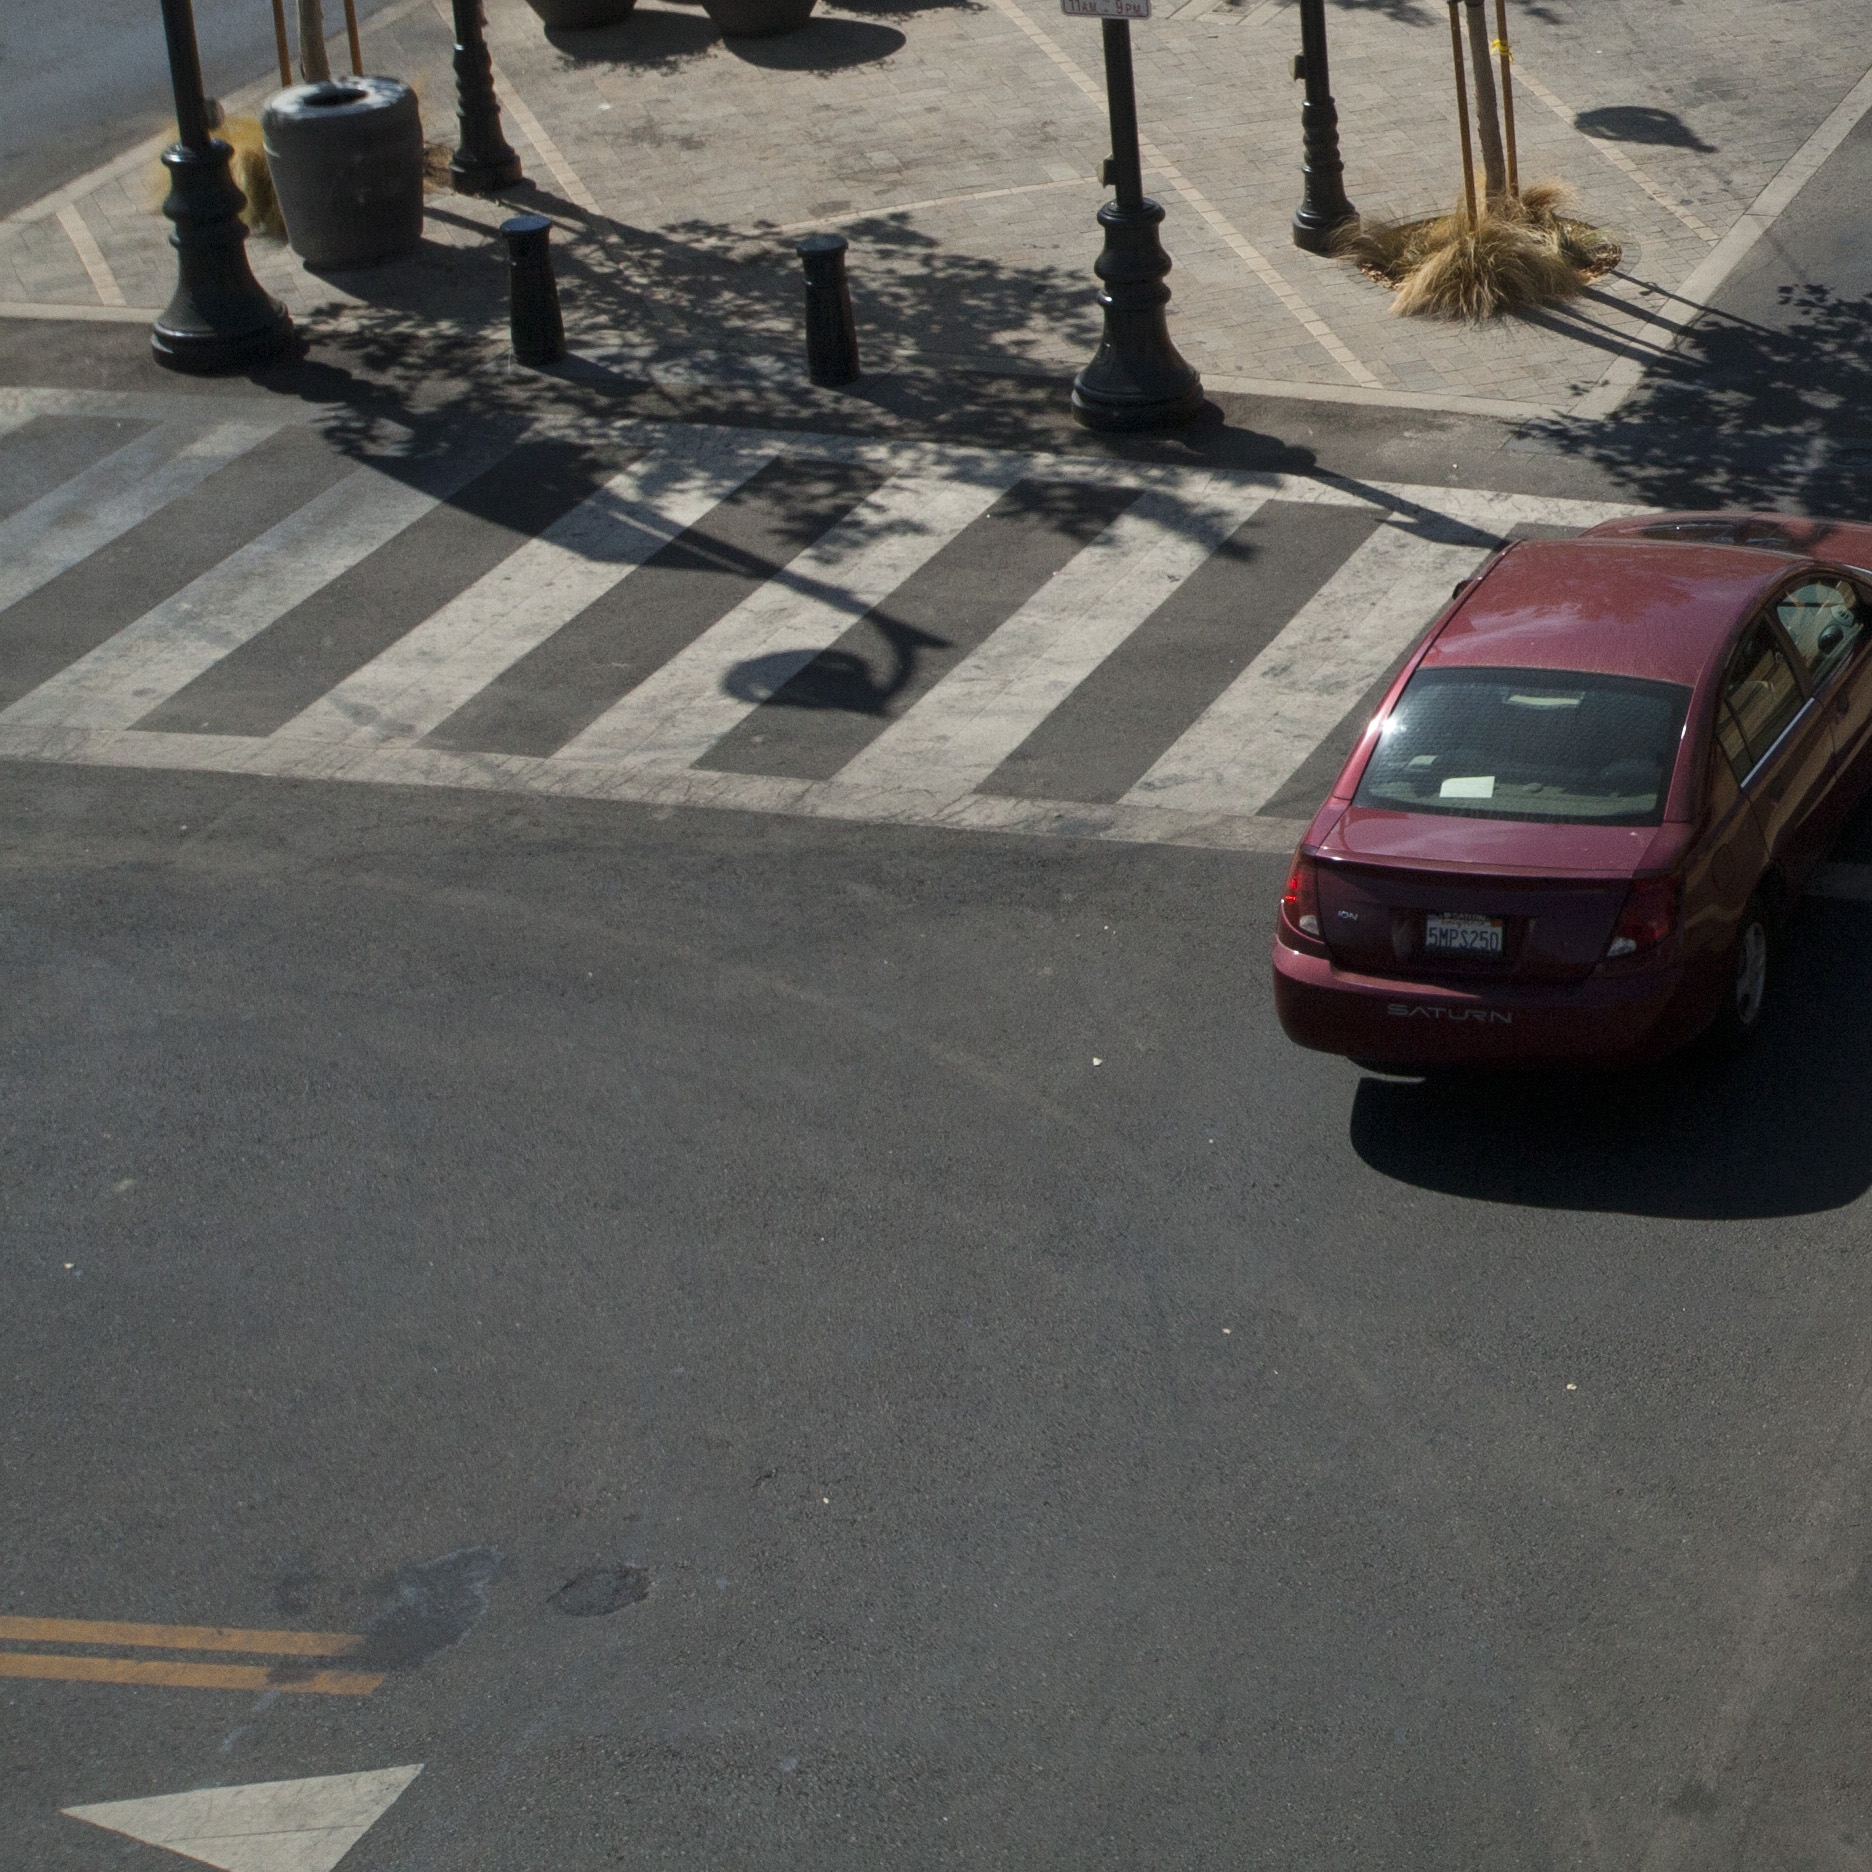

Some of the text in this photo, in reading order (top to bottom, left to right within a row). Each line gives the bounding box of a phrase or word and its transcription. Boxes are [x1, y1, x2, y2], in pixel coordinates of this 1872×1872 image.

[1337, 909, 1359, 921] ION
[1427, 926, 1500, 949] 5MPS250
[1386, 1002, 1513, 1024] SATURN
